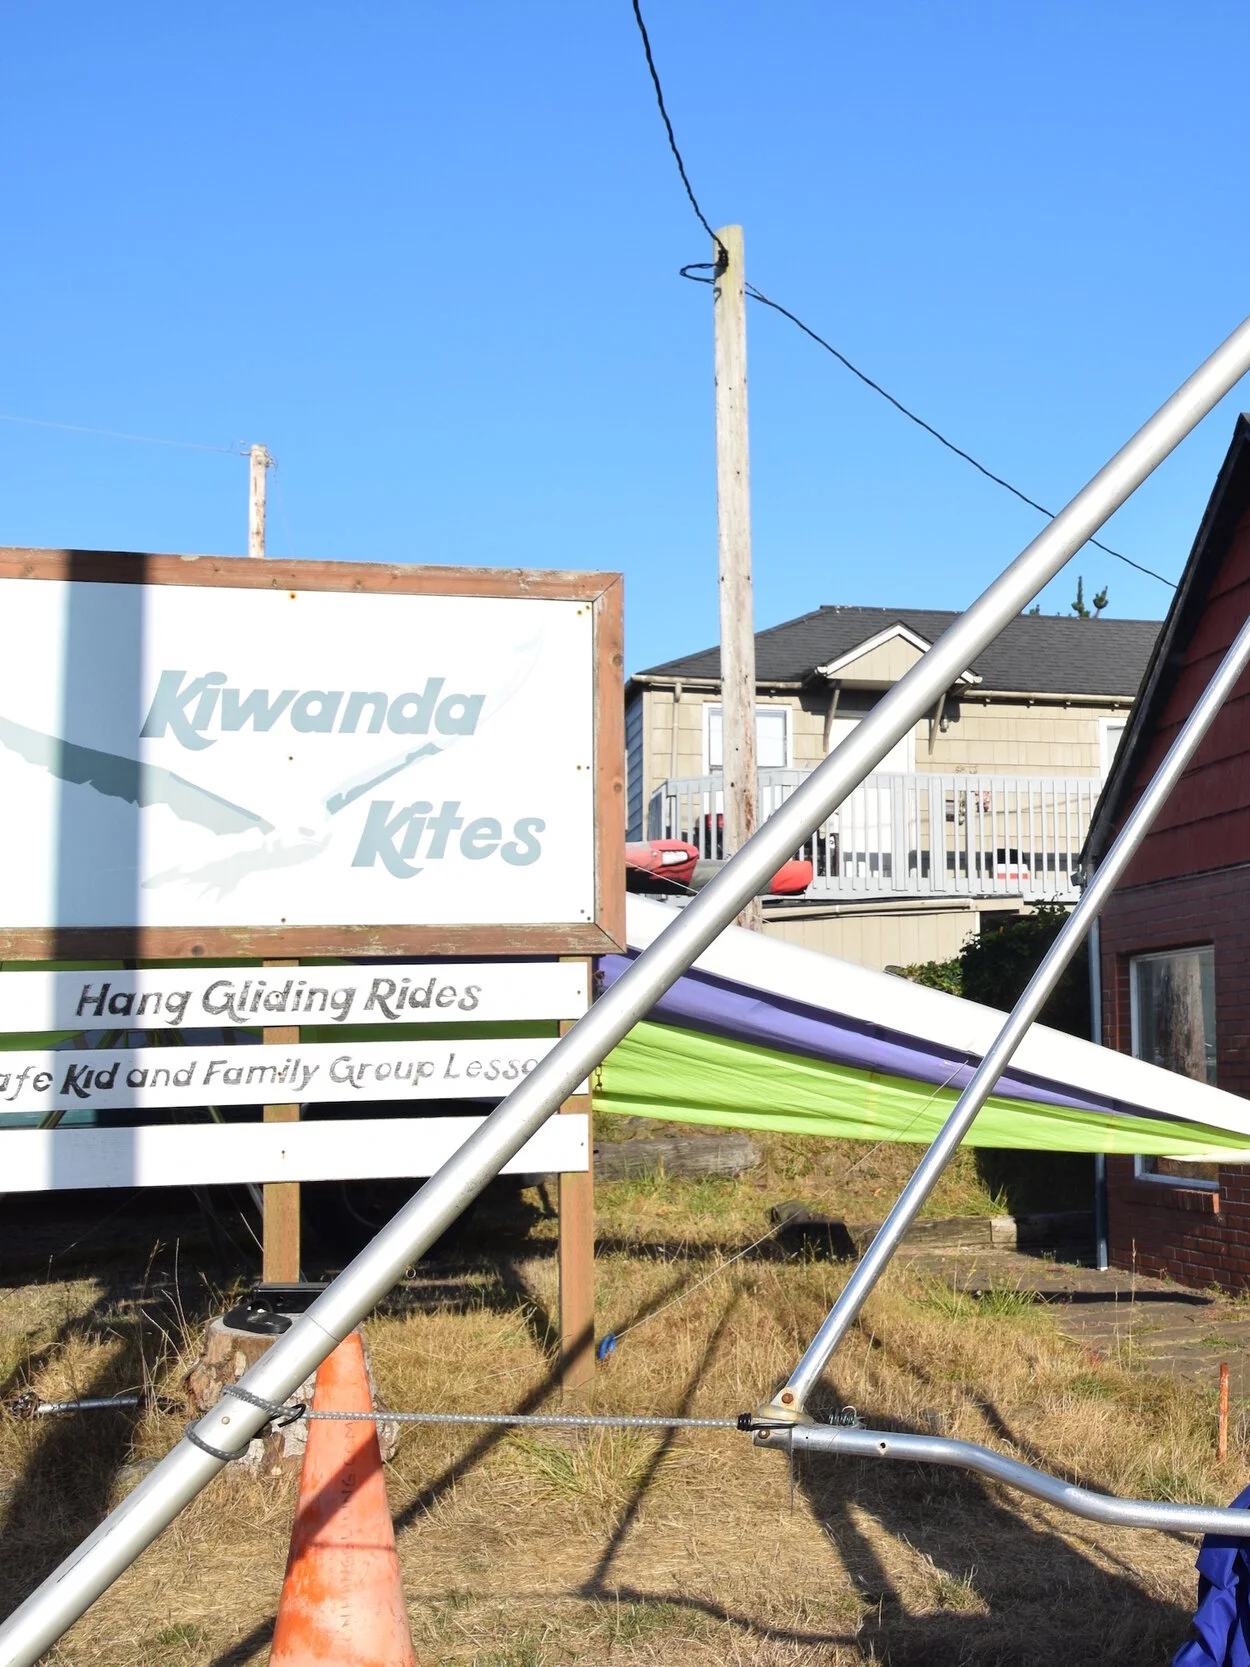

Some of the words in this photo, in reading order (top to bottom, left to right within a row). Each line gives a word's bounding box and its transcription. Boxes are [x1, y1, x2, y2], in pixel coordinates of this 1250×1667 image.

[139, 670, 486, 751] Kiwanda
[350, 801, 546, 880] Kites
[75, 983, 193, 1026] Hang
[202, 979, 357, 1024] Gliding
[364, 976, 482, 1021] Rides
[60, 1062, 121, 1099] Kid
[126, 1060, 198, 1088] and
[202, 1057, 320, 1092] Family
[329, 1055, 435, 1089] Group
